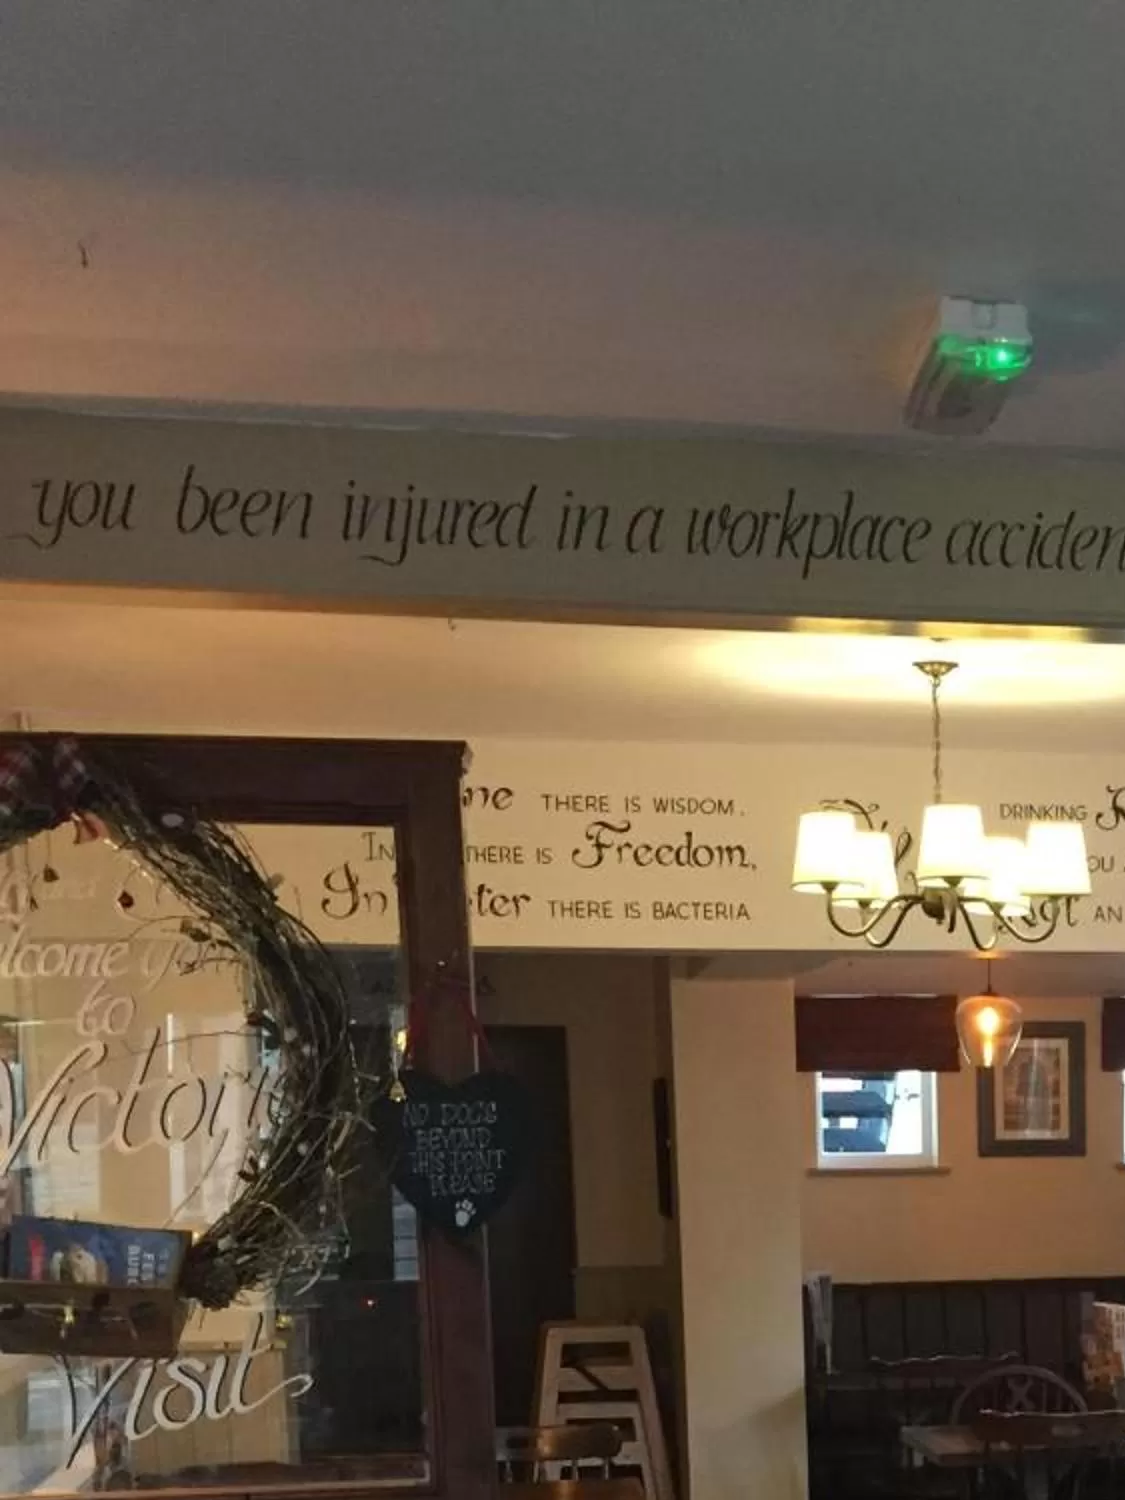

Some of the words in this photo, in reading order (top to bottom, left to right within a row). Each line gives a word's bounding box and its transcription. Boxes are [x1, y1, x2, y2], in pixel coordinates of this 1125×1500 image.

[7, 479, 136, 550] you
[176, 464, 313, 540] been
[341, 479, 538, 566] injured
[556, 490, 609, 552] in
[625, 505, 665, 554] a
[686, 487, 932, 579] workplace
[462, 786, 513, 810] ne
[540, 792, 610, 813] THERE
[623, 794, 642, 814] IS
[998, 801, 1089, 822] DRINKING
[465, 845, 524, 865] THERE
[535, 847, 554, 865] IS
[1086, 855, 1116, 874] OU
[320, 861, 388, 919] In
[468, 883, 532, 919] ter
[547, 899, 613, 920] THERE
[623, 900, 642, 920] IS
[651, 900, 751, 921] BACTERIA
[1093, 904, 1123, 924] AN
[0, 924, 130, 978] lcome
[76, 980, 137, 1037] to
[56, 1310, 315, 1470] Visit
